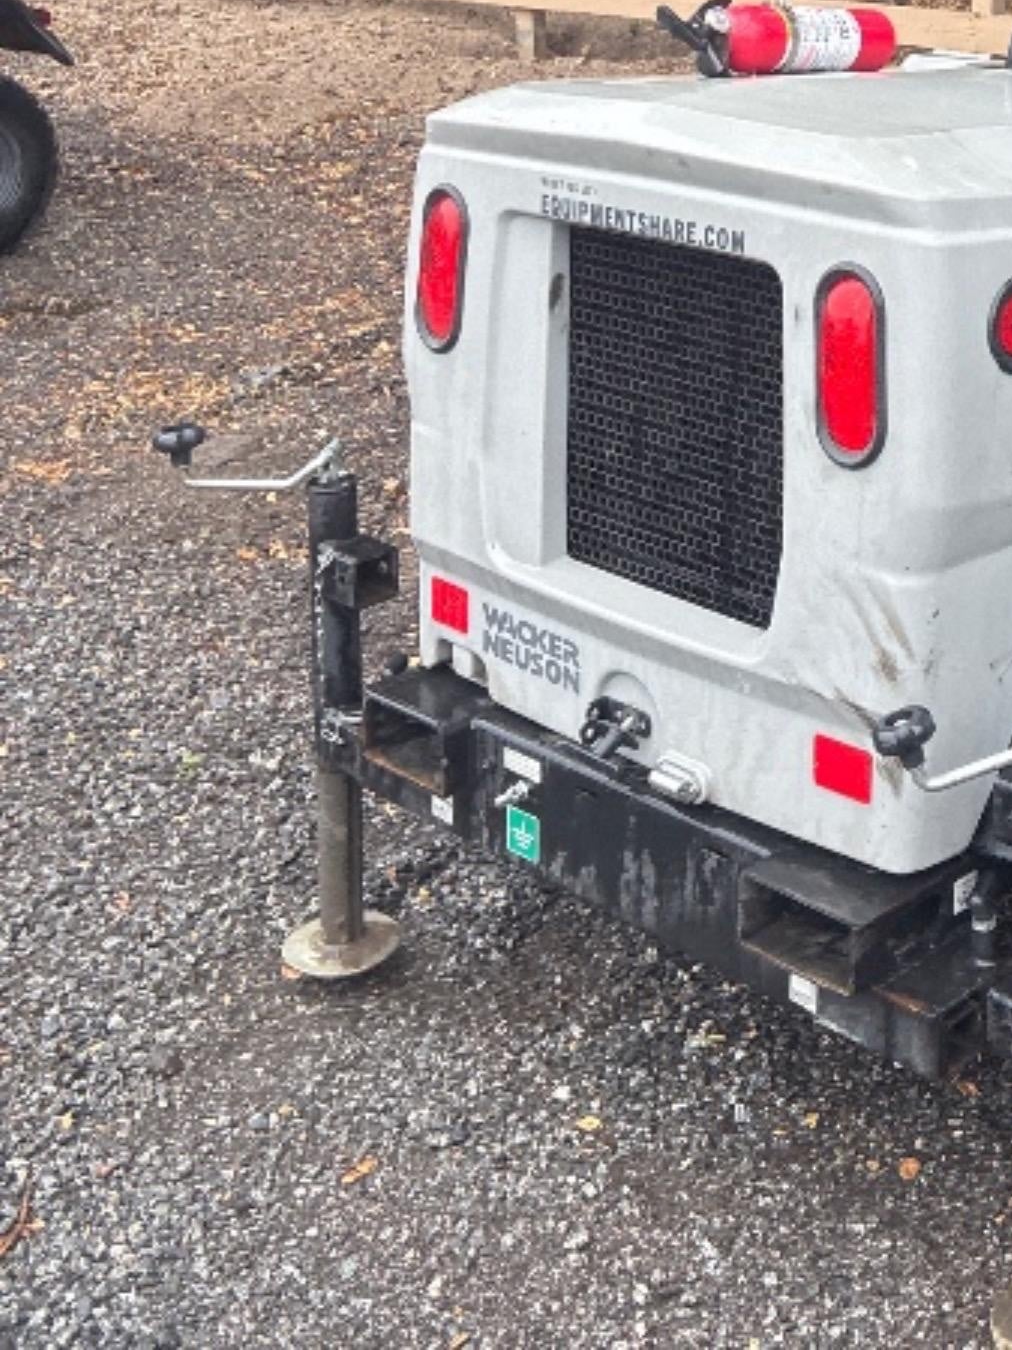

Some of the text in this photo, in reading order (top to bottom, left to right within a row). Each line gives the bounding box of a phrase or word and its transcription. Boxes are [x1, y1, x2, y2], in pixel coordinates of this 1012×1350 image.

[541, 194, 746, 253] EQUIPMENTSHARE.COM
[482, 602, 580, 666] WACKER
[482, 630, 580, 694] NEUSON
